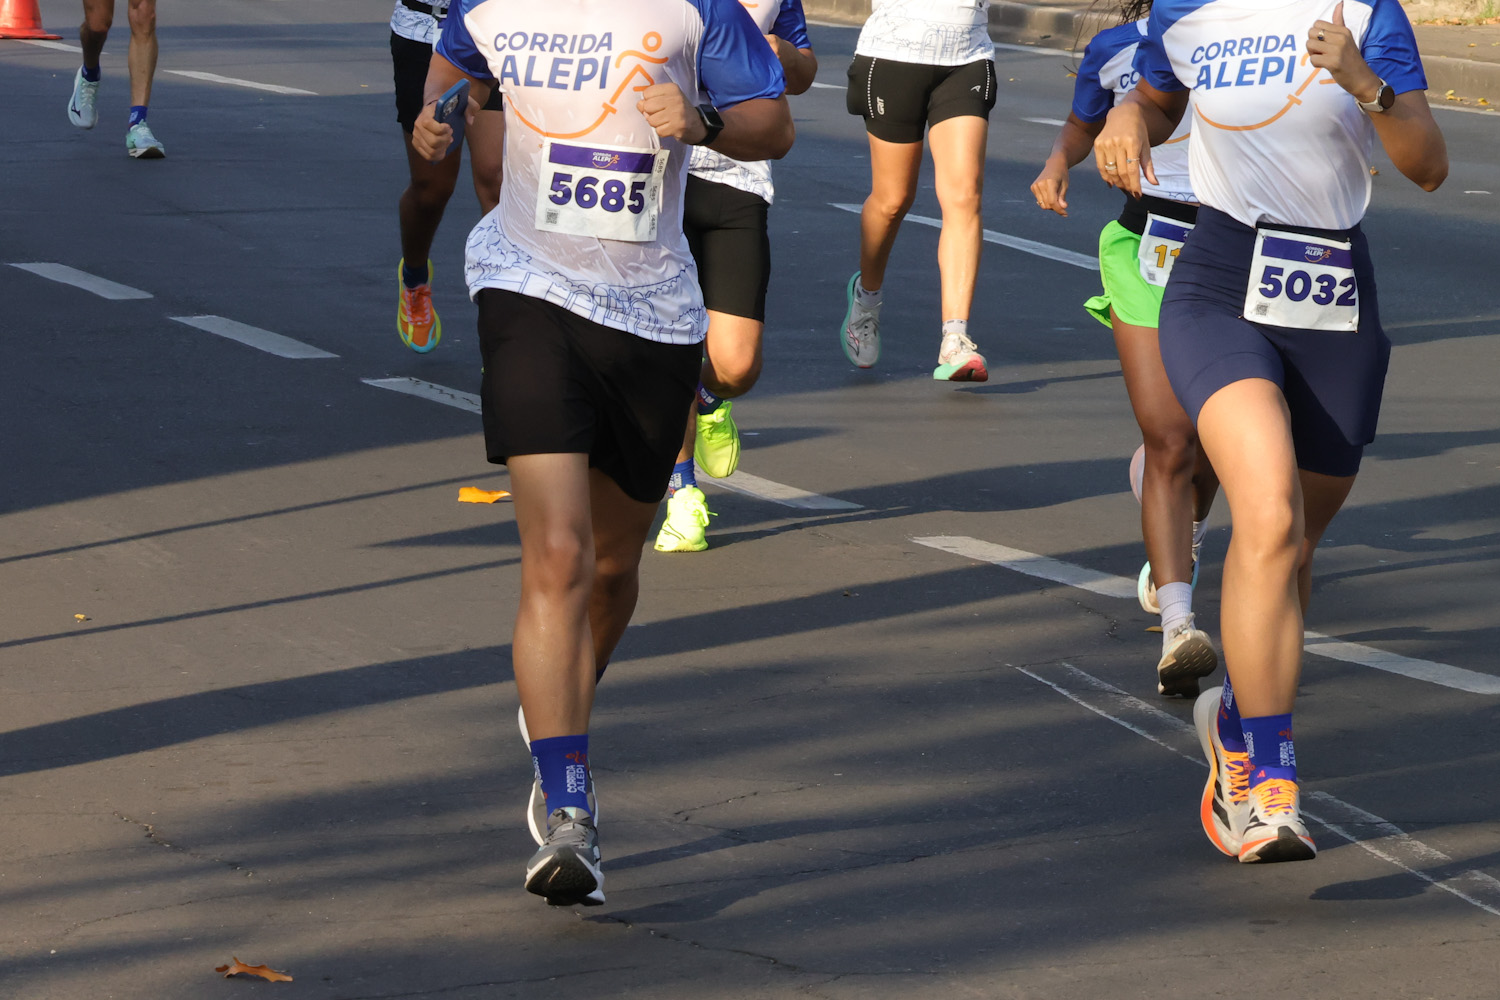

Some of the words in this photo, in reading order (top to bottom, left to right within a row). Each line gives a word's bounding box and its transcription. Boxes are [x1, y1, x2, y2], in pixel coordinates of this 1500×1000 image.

[494, 31, 612, 55] CORRIDA
[1191, 34, 1297, 64] CORRIDA
[501, 54, 611, 91] ALEPI
[1193, 56, 1297, 91] ALEPI
[548, 171, 647, 215] 5685
[1258, 265, 1357, 307] 5032
[576, 764, 586, 794] ALEPI
